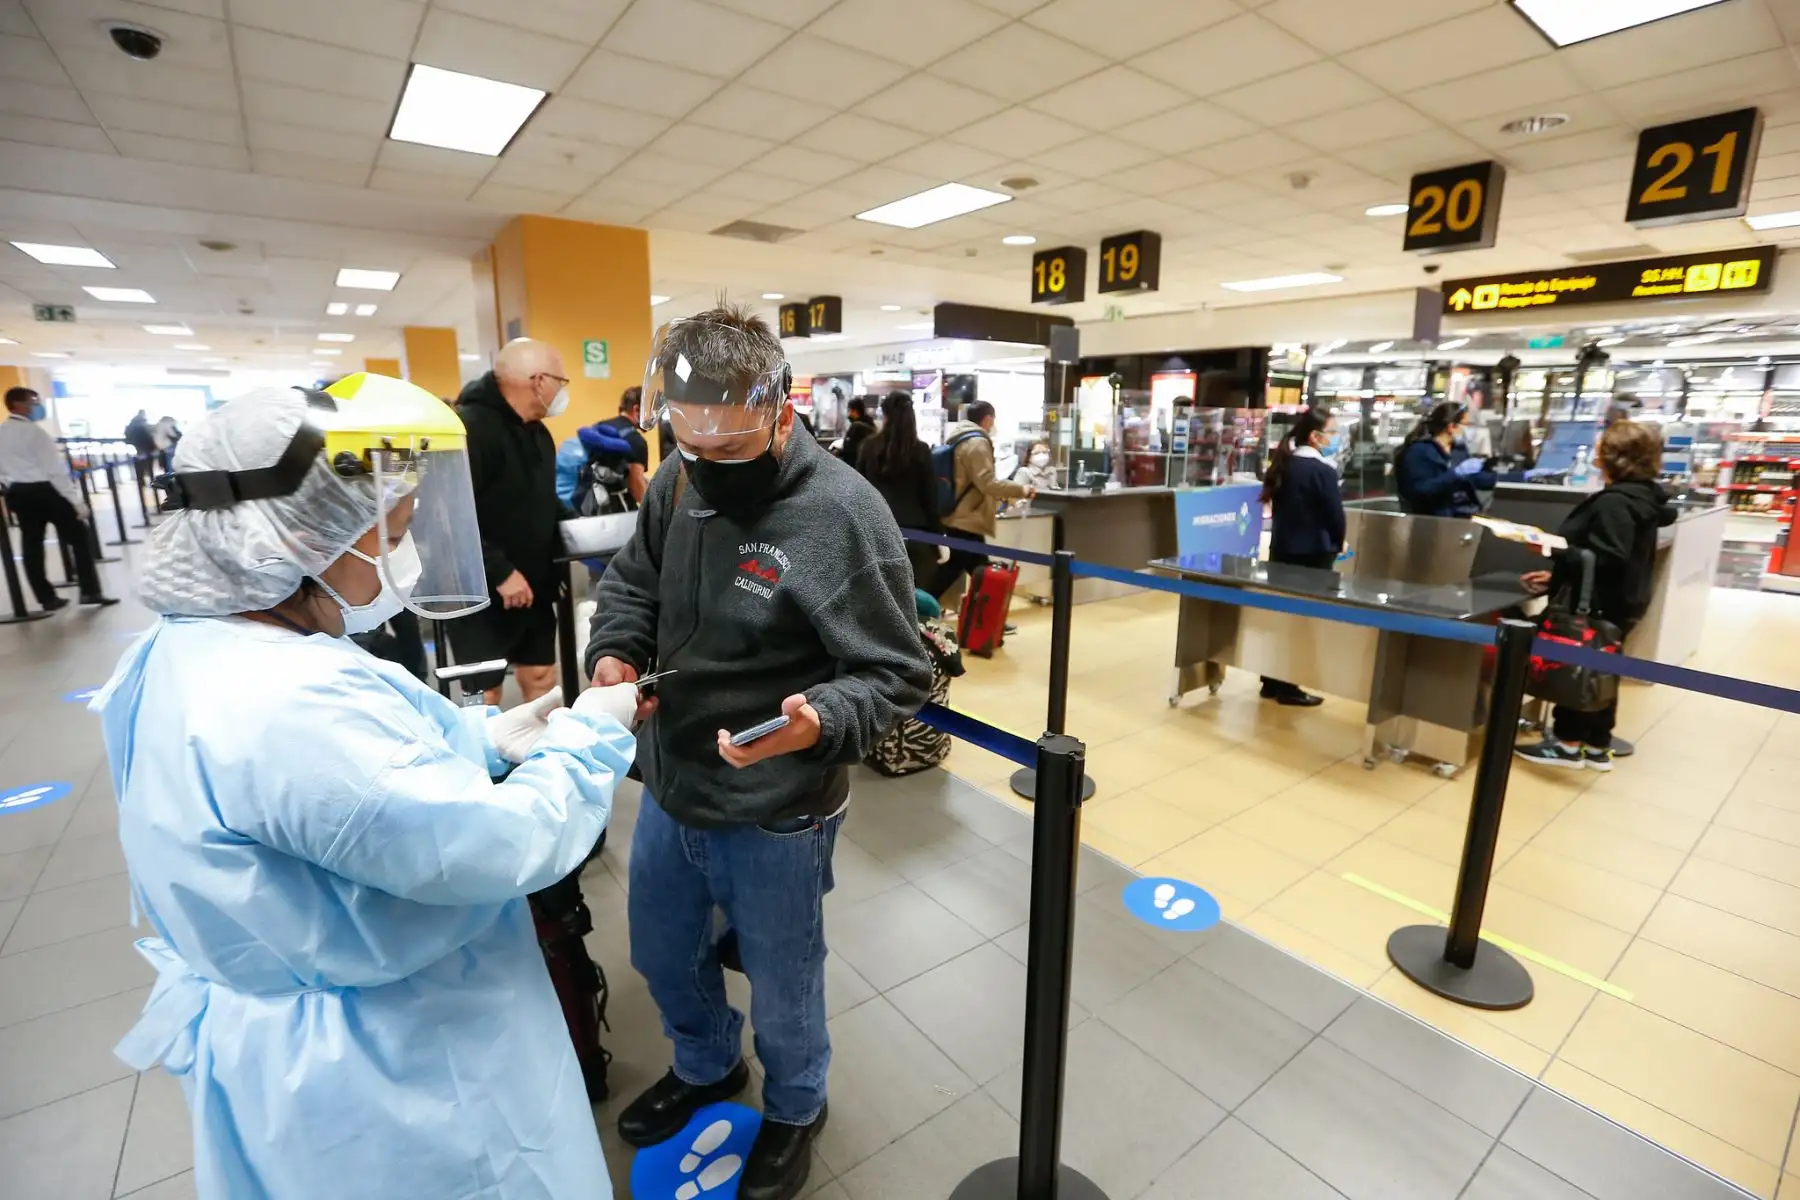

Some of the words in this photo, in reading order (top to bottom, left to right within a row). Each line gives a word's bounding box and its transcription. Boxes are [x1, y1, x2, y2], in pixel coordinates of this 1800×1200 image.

[1639, 131, 1738, 204] 21
[1408, 179, 1482, 237] 20
[1035, 258, 1065, 294] 18
[1104, 243, 1139, 283] 19
[781, 310, 795, 332] 16
[809, 303, 826, 328] 17
[587, 342, 604, 361] S
[738, 543, 757, 554] SAN
